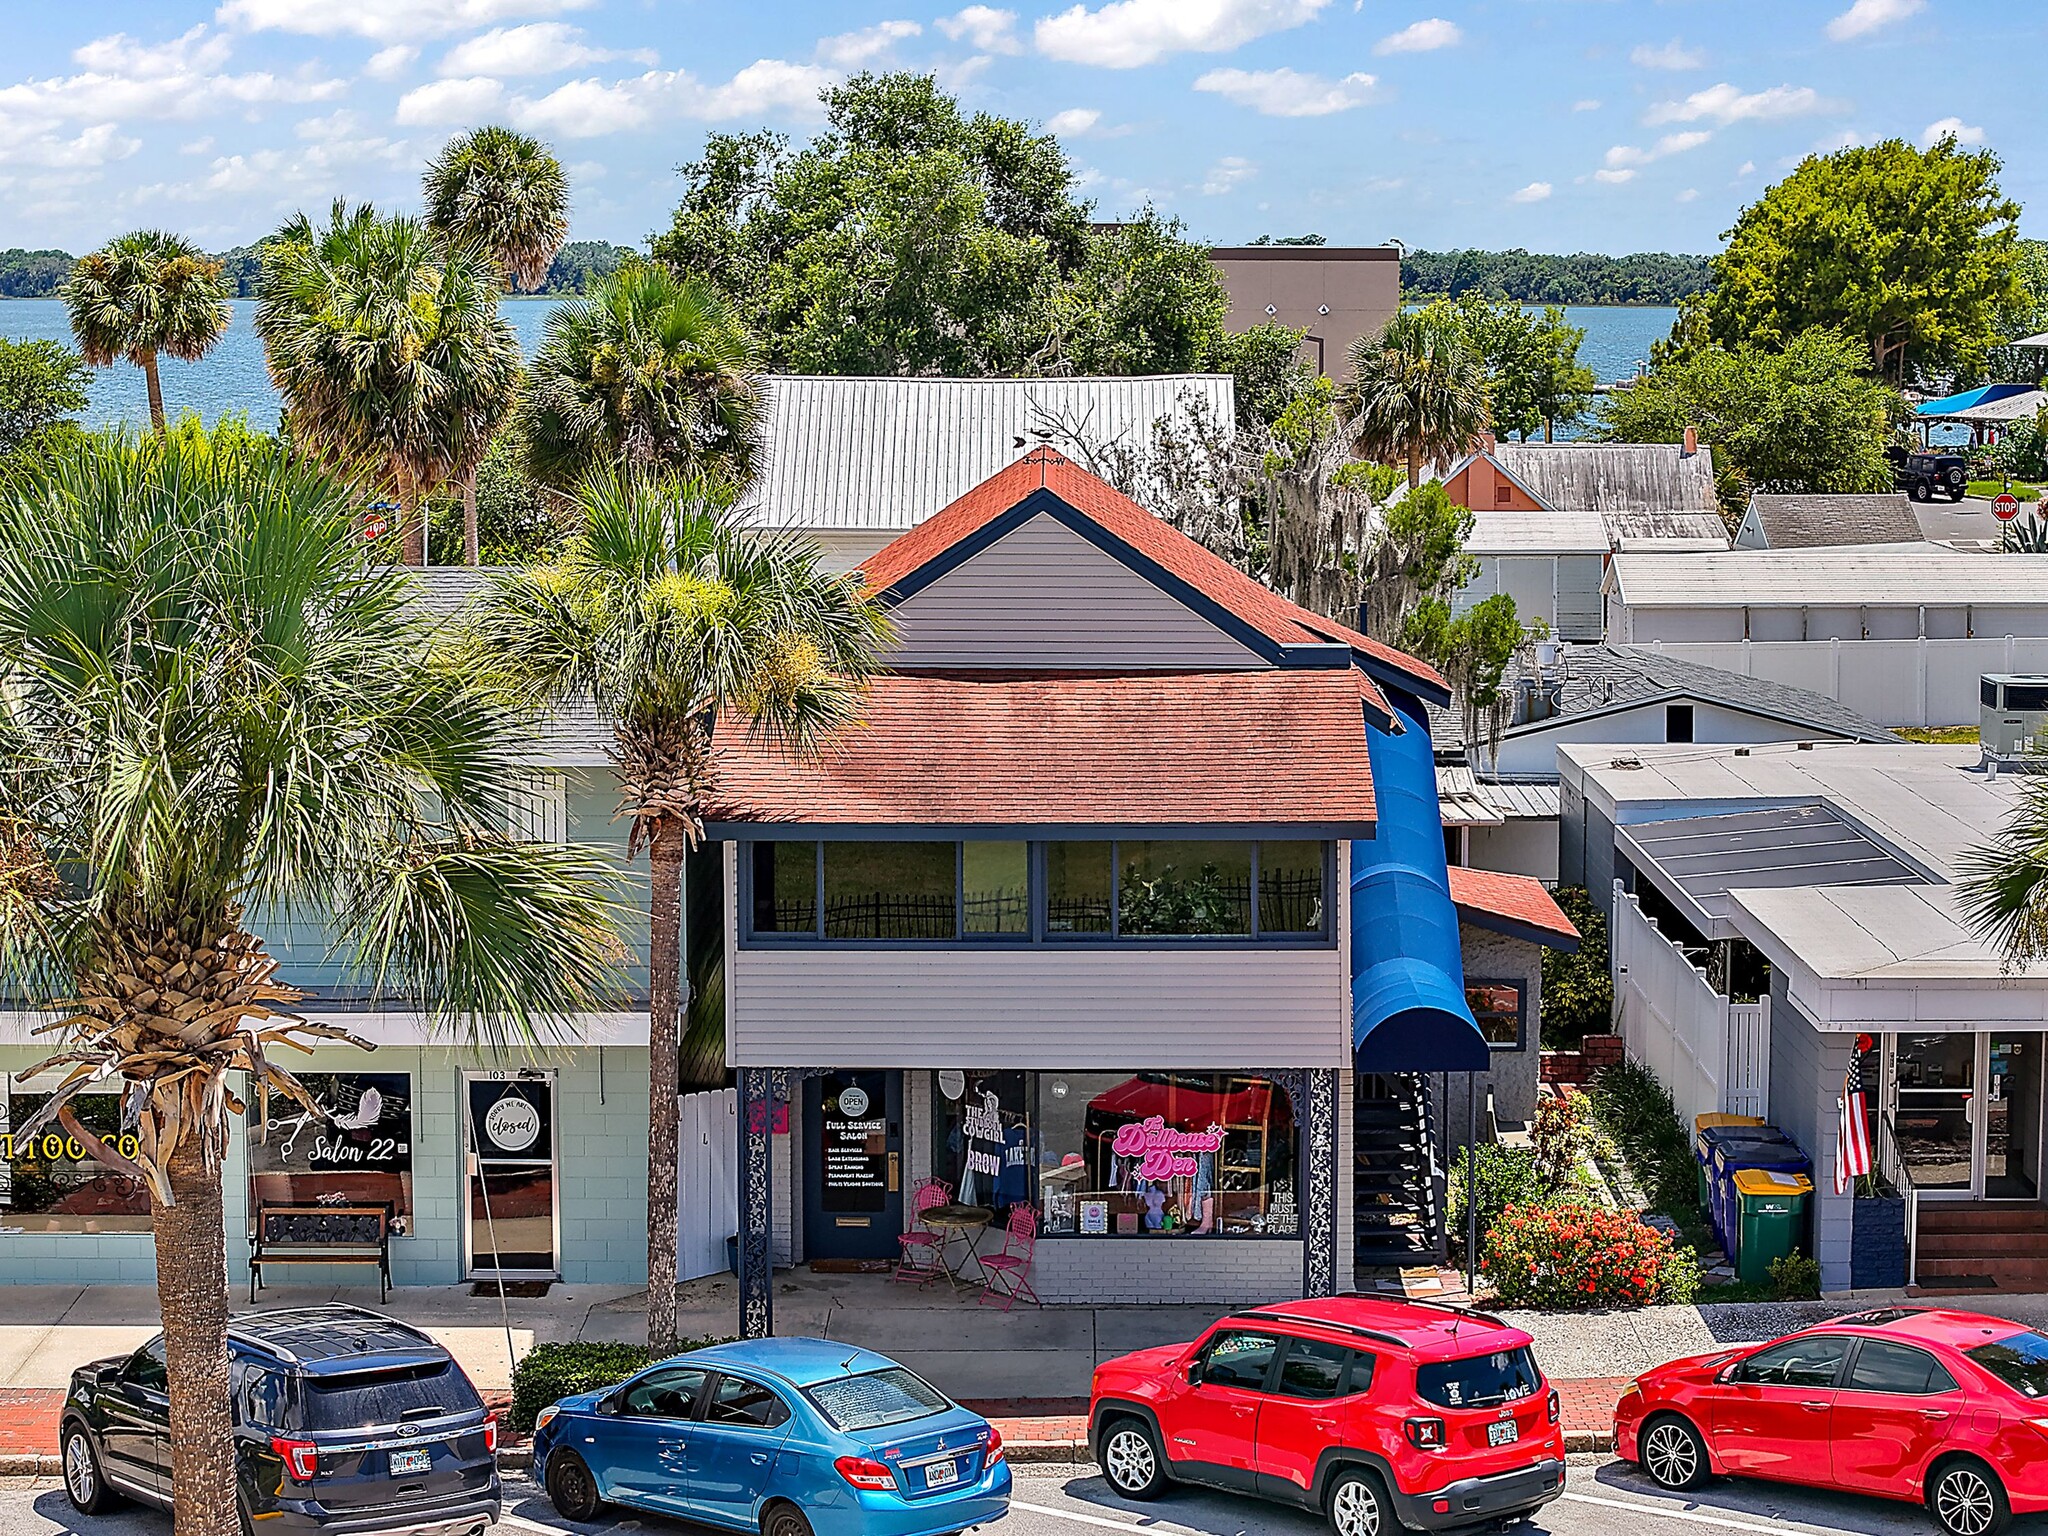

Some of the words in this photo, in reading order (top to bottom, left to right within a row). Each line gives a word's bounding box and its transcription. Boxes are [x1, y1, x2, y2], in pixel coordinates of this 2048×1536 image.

[1994, 502, 2016, 513] STOP
[489, 1071, 506, 1080] 103
[843, 1097, 863, 1106] OPEN
[489, 1103, 505, 1121] SORRY
[965, 1104, 984, 1118] THE
[492, 1116, 534, 1136] closed
[963, 1123, 1006, 1145] COWGIRL
[1113, 1122, 1221, 1157] Dollhouse
[308, 1134, 364, 1163] Salon
[366, 1138, 395, 1161] 22
[968, 1149, 1001, 1177] BROW
[1141, 1150, 1198, 1181] Den
[1272, 1192, 1294, 1203] THIS
[1270, 1203, 1298, 1214] MUST
[1267, 1214, 1279, 1224] BE
[1282, 1214, 1299, 1224] THE
[1267, 1225, 1298, 1235] PLACE
[1504, 1383, 1531, 1400] LOVE
[1499, 1409, 1514, 1418] Jeep
